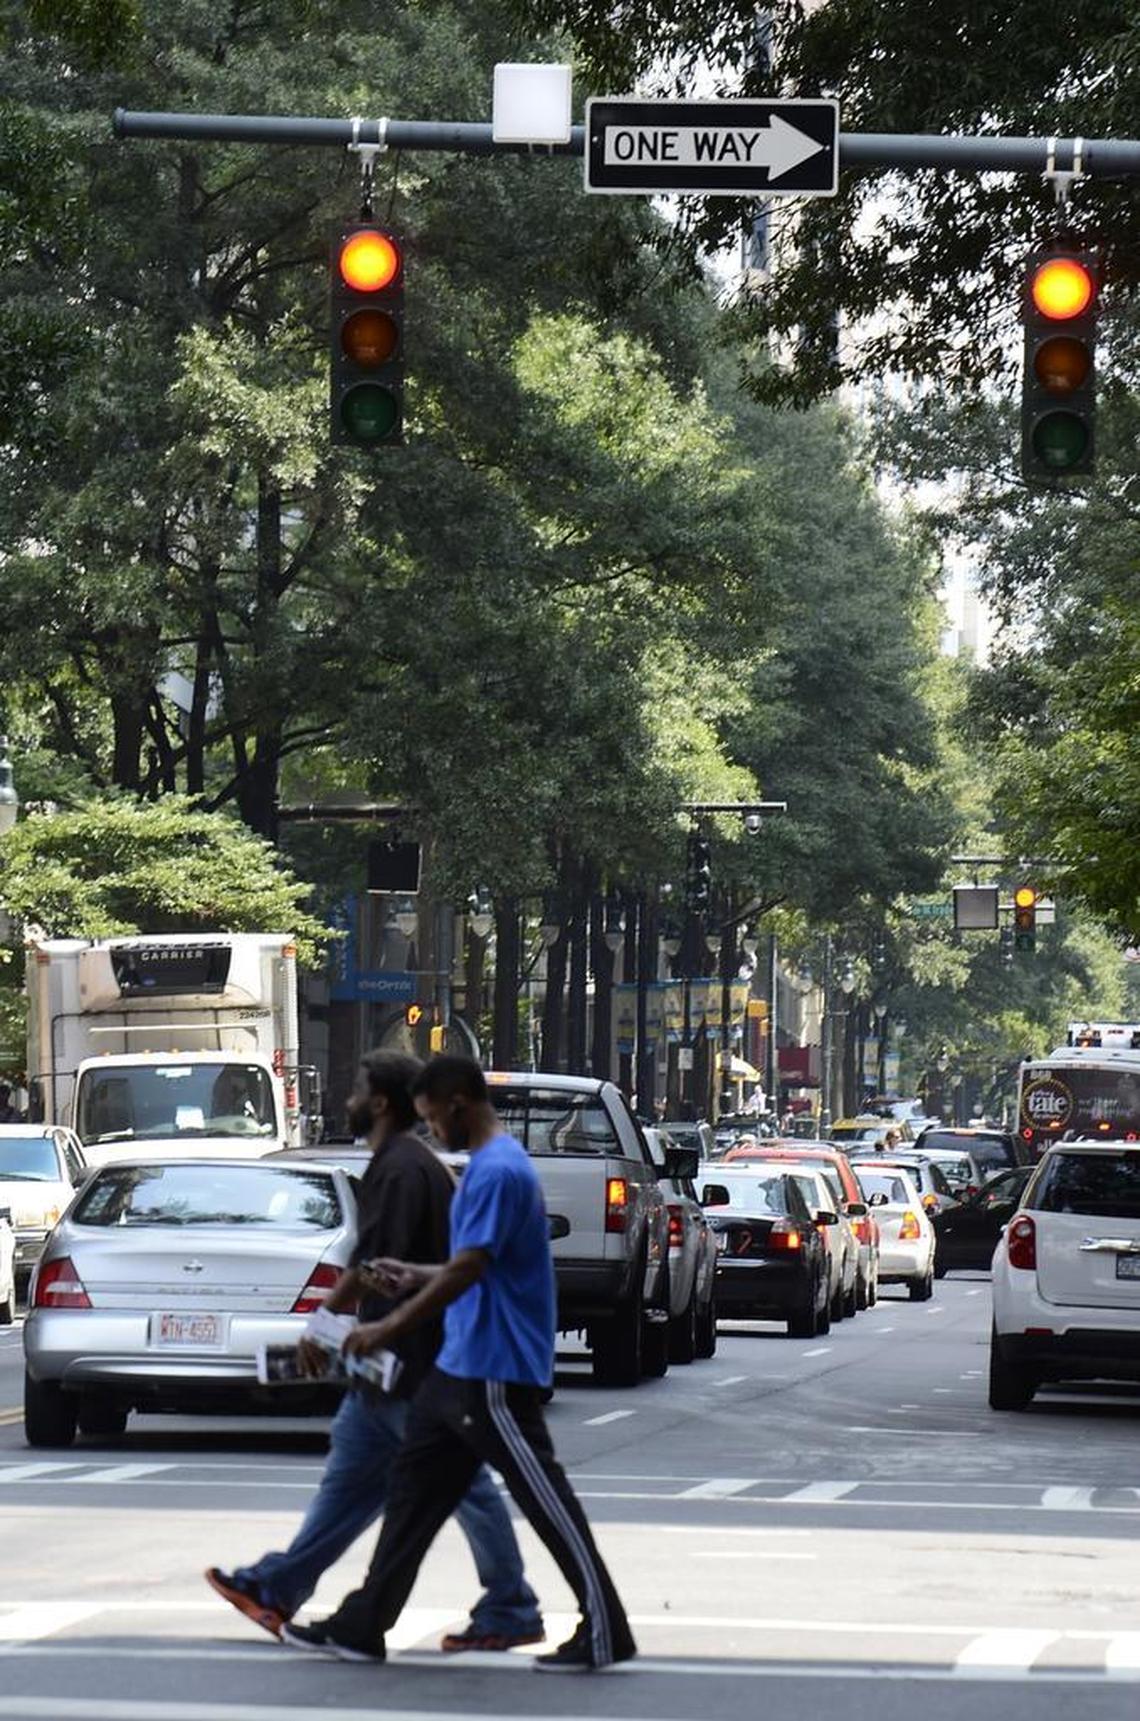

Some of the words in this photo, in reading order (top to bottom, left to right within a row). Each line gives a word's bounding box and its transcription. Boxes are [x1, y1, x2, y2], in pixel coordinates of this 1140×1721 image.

[614, 131, 678, 161] ONE
[693, 132, 760, 162] WAY
[141, 949, 204, 961] CARRIER
